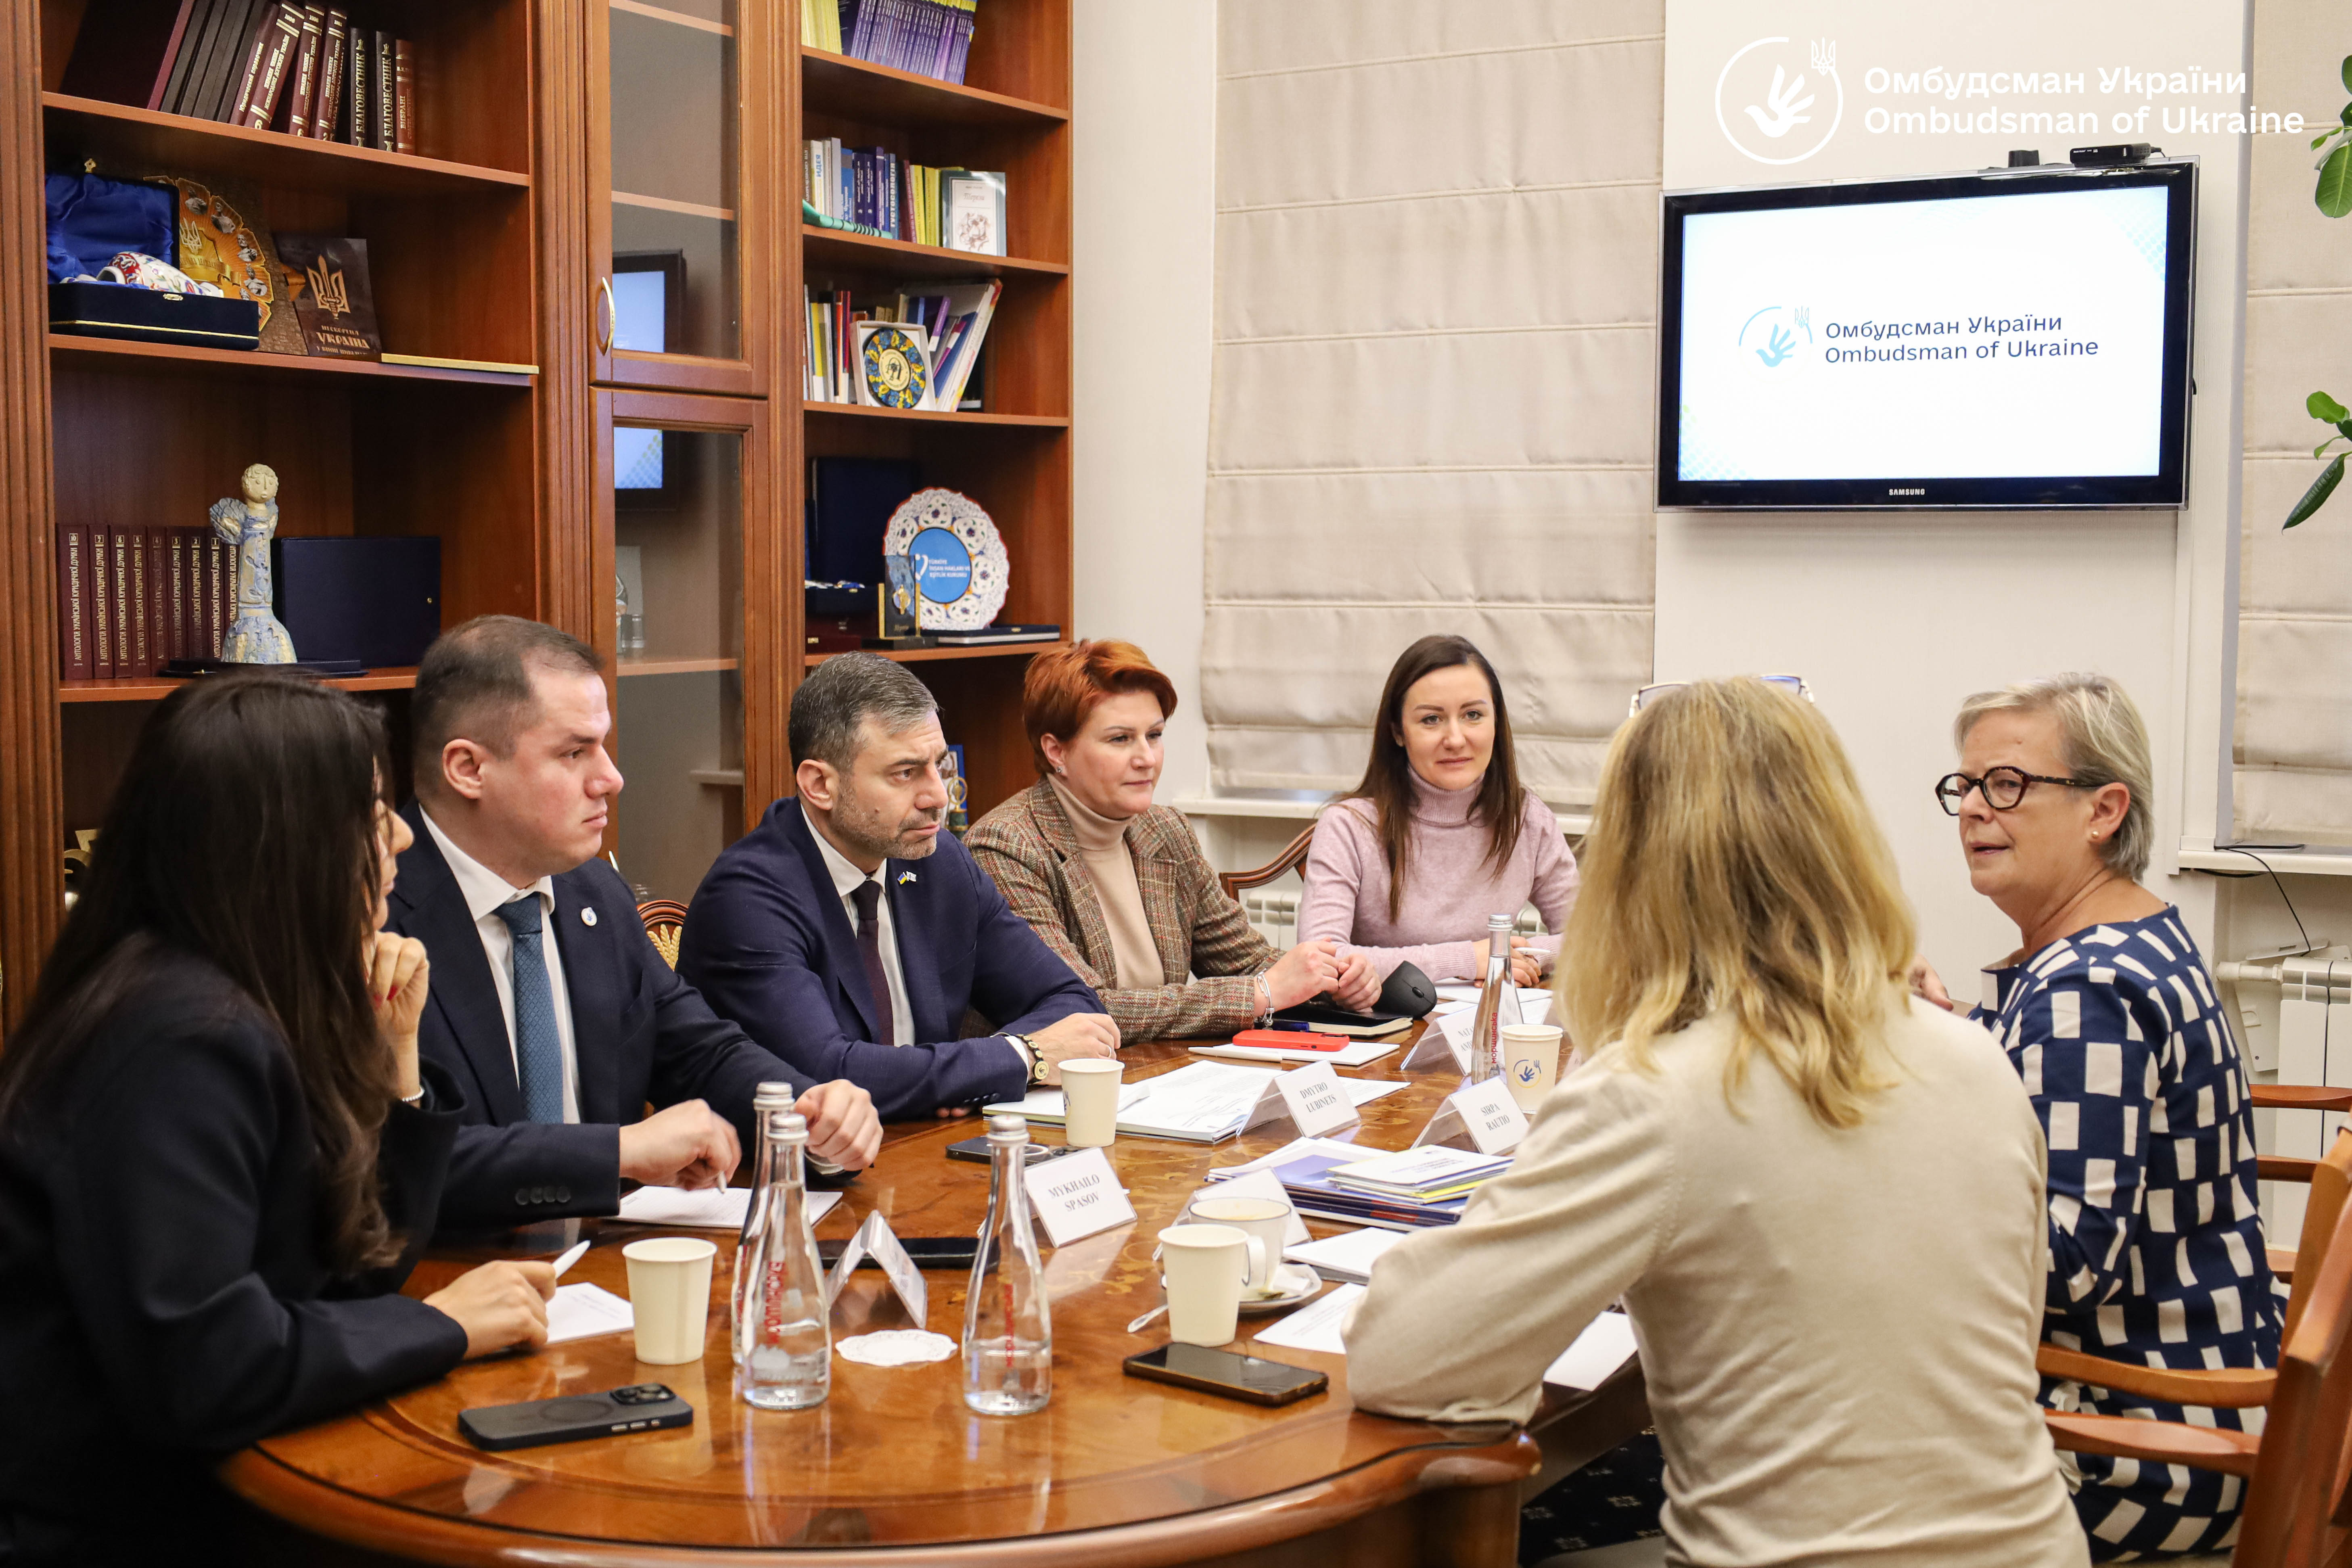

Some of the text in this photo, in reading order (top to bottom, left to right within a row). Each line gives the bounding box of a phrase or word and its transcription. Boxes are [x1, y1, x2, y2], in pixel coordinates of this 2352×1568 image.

[280, 34, 290, 54] УКРАЇНИ
[239, 42, 264, 112] Юридический справочник
[356, 53, 365, 134] БЛАГОВЕСТНИК
[382, 57, 393, 138] БЛАГОВЕСТНИК
[1826, 314, 2062, 341] Омбудсман України
[1825, 339, 2099, 363] Ombudsman of Ukraine
[96, 548, 105, 567] ДУМКИ
[117, 549, 125, 567] ДУМКИ
[172, 550, 181, 568] ДУМКИ
[192, 550, 200, 568] ДУМКИ
[211, 551, 220, 569] ДУМКИ
[95, 567, 105, 597] ЮРИДИЧНОЇ
[116, 568, 125, 598] ЮРИДИЧНОЇ
[172, 568, 181, 598] ЮРИДИЧНОЇ
[191, 568, 200, 598] ЮРИДИЧНОЇ
[211, 569, 220, 598] ЮРИДИЧНОЇ
[69, 548, 82, 661] АНТОЛОГІЯ УКРАЇНСЬКОЇ ЮРИДИЧНОЇ ДУМКИ
[96, 598, 106, 631] УКРАЇНСЬКОЇ
[117, 599, 126, 631] УКРАЇНСЬКОЇ
[134, 550, 145, 660] АНТОЛОГІЯ УКРАЇНСЬКОЇ ЮРИДИЧНОЇ ДУМКИ
[172, 598, 181, 629] УКРАЇНСЬКОЇ
[211, 599, 220, 628] УКРАЇНСЬКОЇ
[1300, 1082, 1328, 1099] DMYTRO
[1306, 1094, 1337, 1112] LUBINETS
[1480, 1103, 1500, 1116] SIRPA
[1486, 1114, 1510, 1131] RAUTIO
[1048, 1174, 1100, 1198] MYKHAILO
[1065, 1192, 1099, 1212] SPASOV
